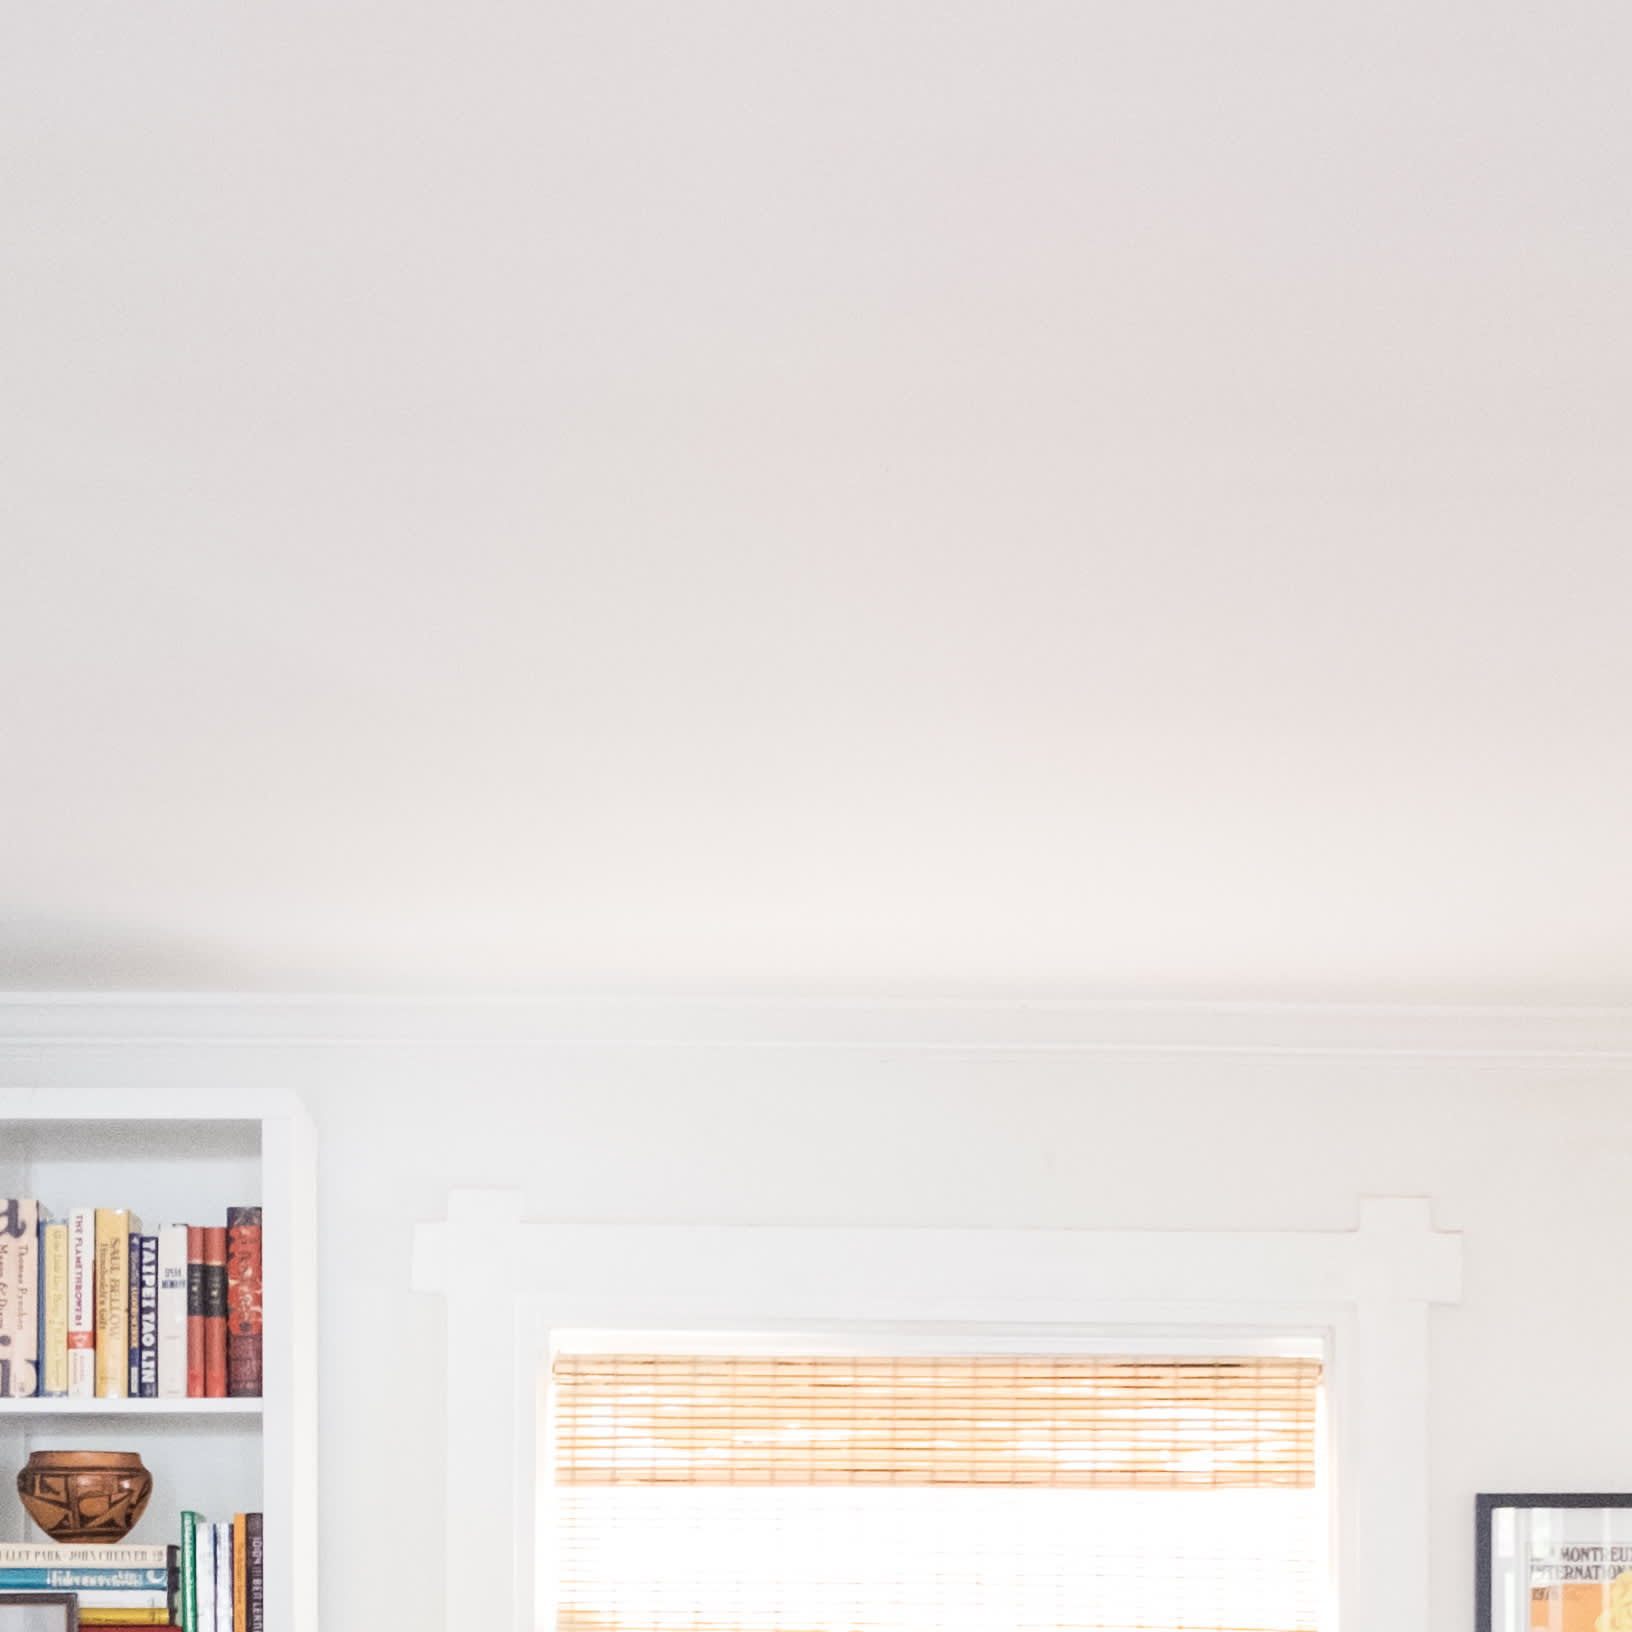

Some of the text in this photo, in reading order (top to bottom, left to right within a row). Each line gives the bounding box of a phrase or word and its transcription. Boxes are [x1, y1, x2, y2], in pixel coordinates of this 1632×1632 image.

[141, 1240, 156, 1384] TAIPEI TAO LIN
